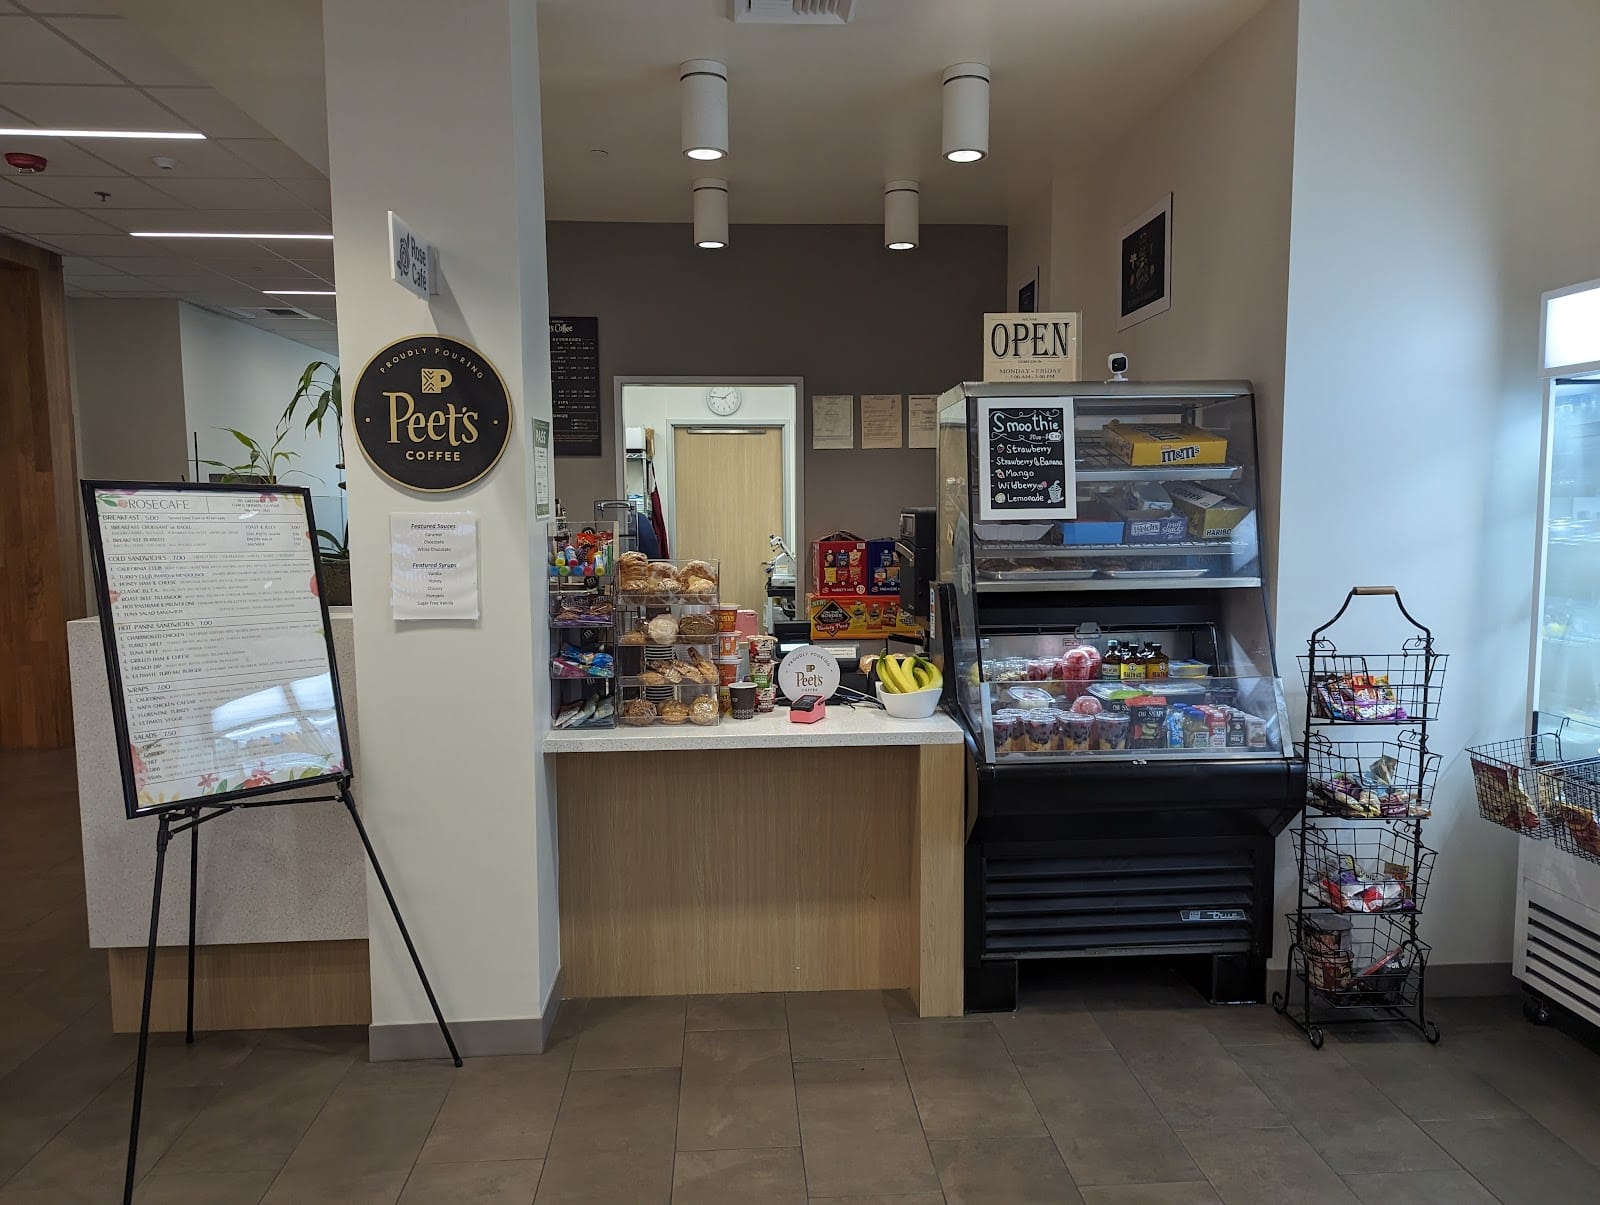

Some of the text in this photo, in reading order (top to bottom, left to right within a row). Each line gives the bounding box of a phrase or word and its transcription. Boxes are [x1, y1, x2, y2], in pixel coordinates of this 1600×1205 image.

[410, 236, 426, 267] Rose
[411, 263, 427, 291] Café
[554, 324, 573, 333] Coffee
[991, 322, 1070, 358] OPEN
[380, 348, 484, 379] PROUDLY POURING
[382, 392, 478, 446] Peet's
[992, 412, 1059, 432] Smoothie
[535, 429, 547, 444] PASS
[405, 450, 461, 462] COFFEE
[1006, 444, 1051, 454] Strawberry
[996, 456, 1033, 467] Strawberry
[1040, 457, 1063, 465] Banana
[1006, 469, 1034, 480] Mango
[998, 481, 1037, 492] Wildberry
[1007, 493, 1044, 502] Lemonade
[787, 652, 808, 666] PROUDLY
[794, 671, 823, 687] Peet's
